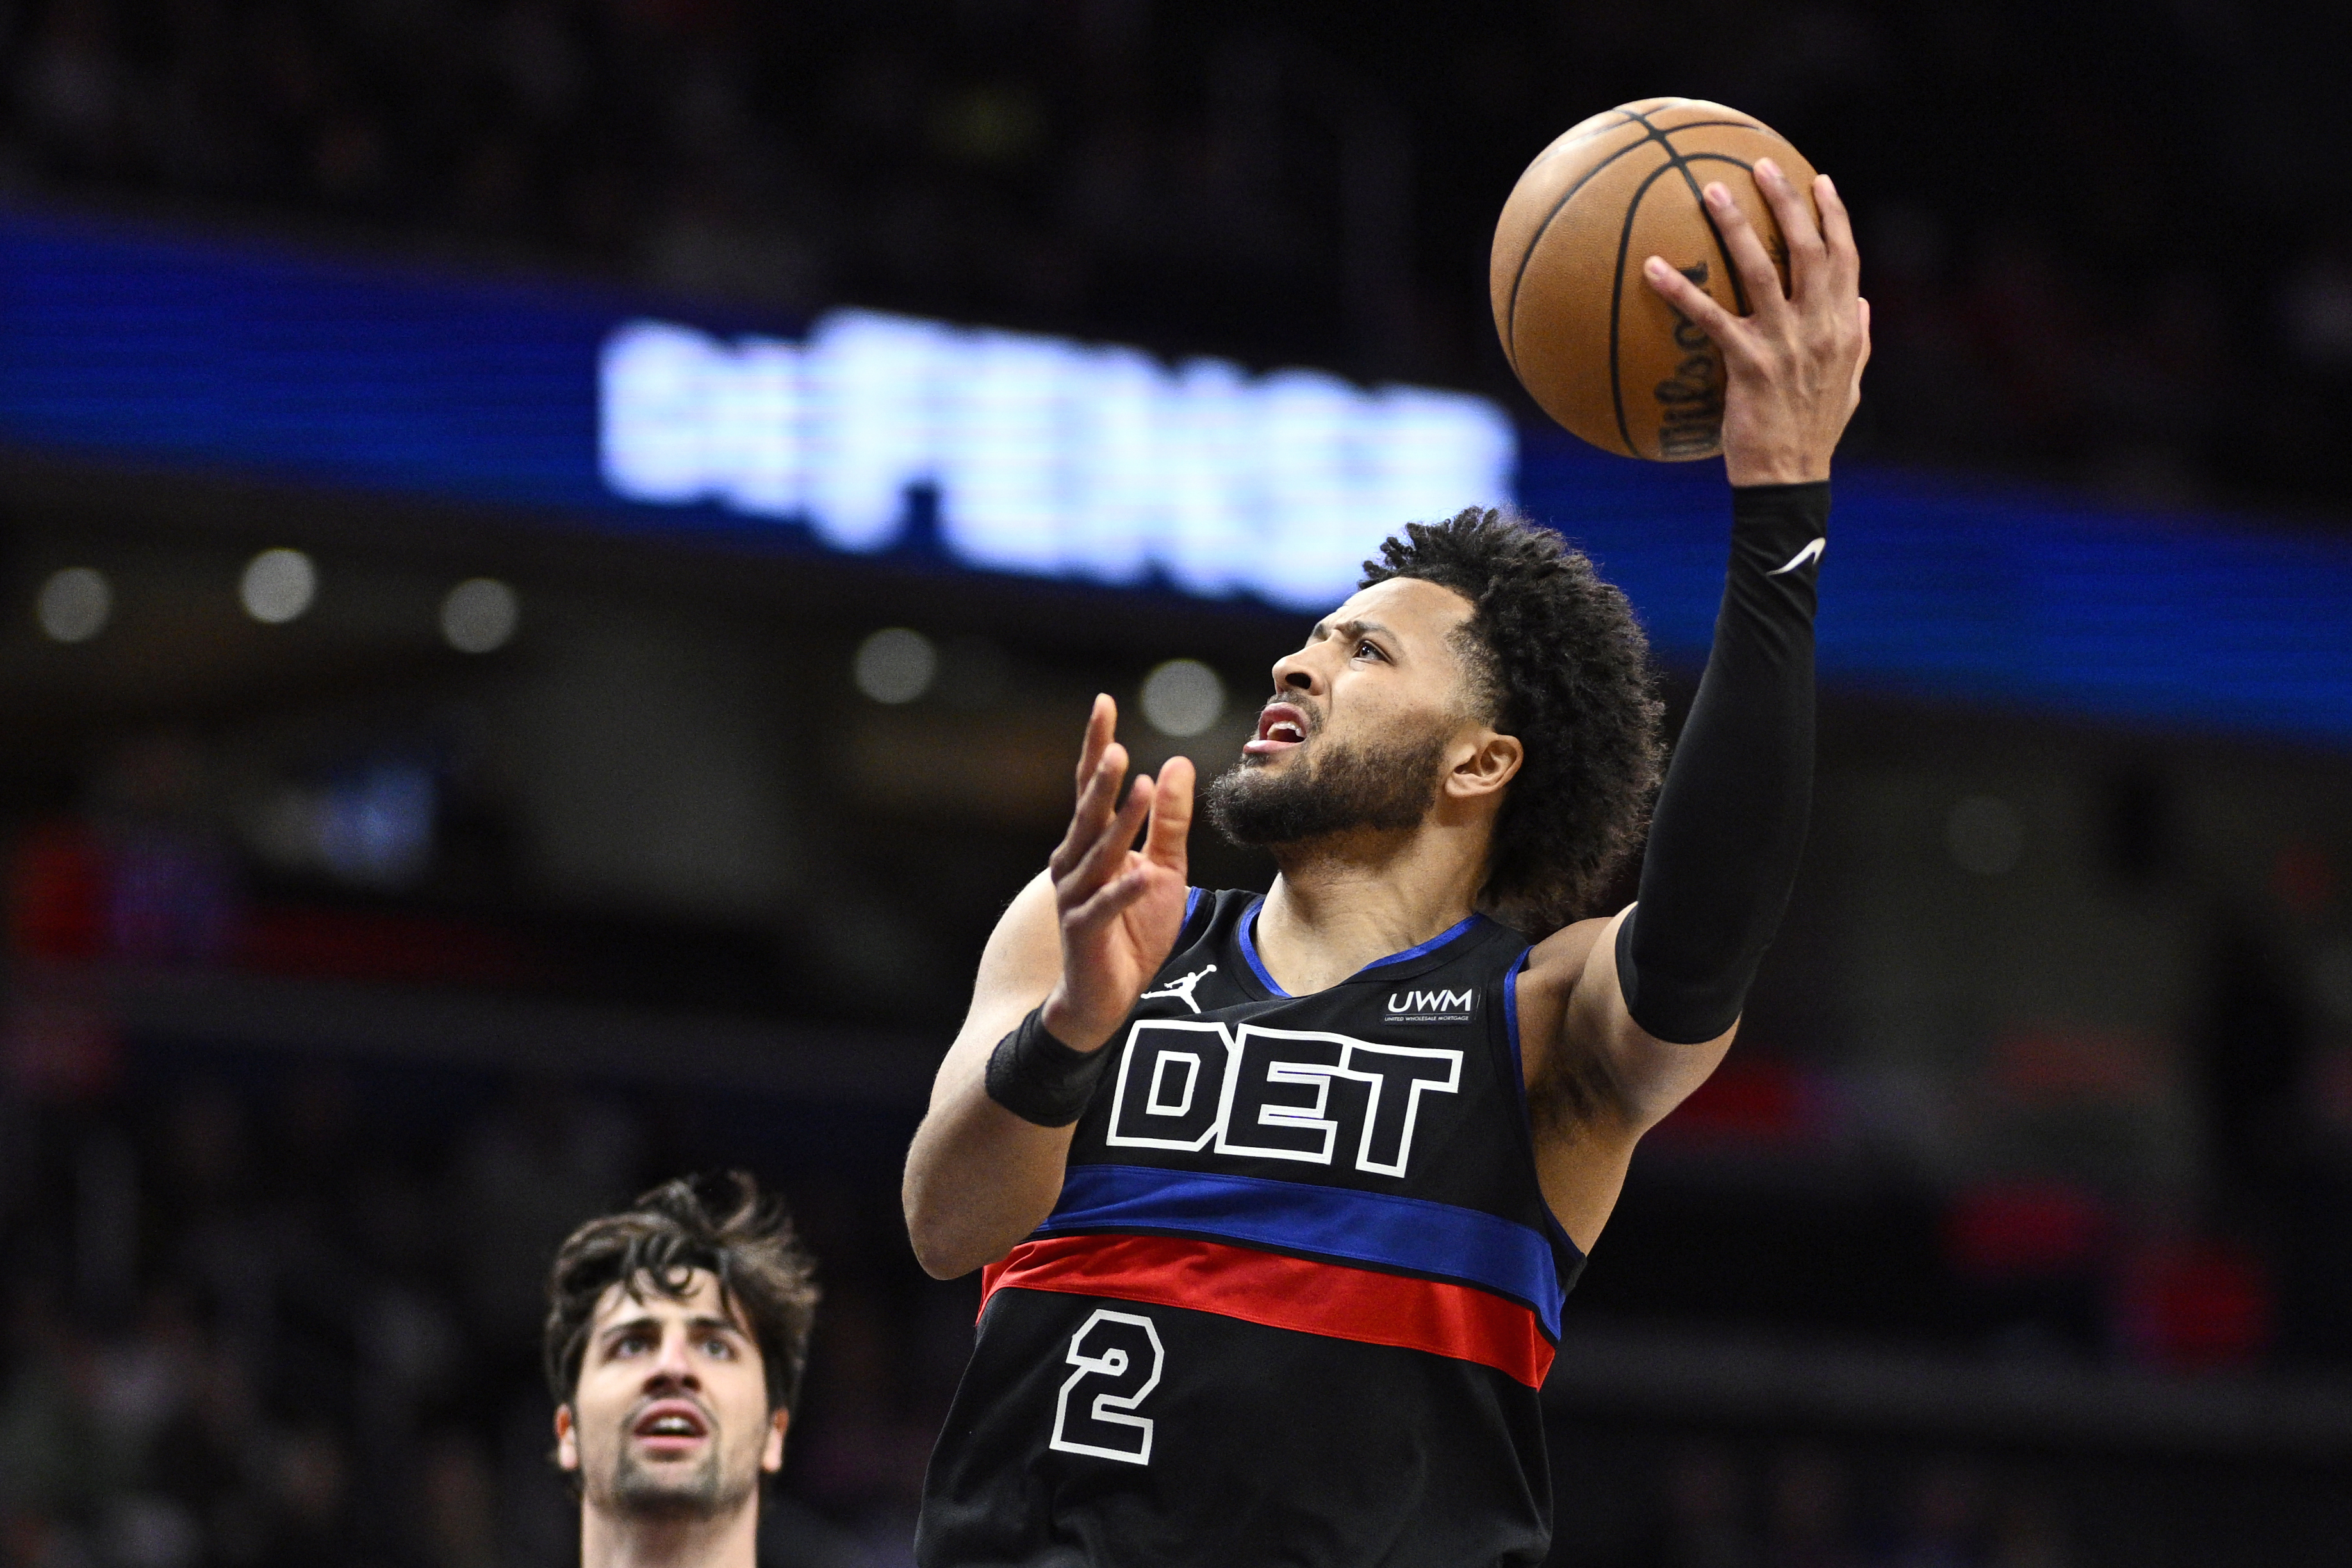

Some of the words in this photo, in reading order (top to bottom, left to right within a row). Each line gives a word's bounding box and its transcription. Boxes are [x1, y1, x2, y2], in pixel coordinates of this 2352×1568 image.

[1388, 988, 1472, 1013] UWM
[1106, 1019, 1463, 1179] DET
[1048, 1308, 1165, 1466] 2
